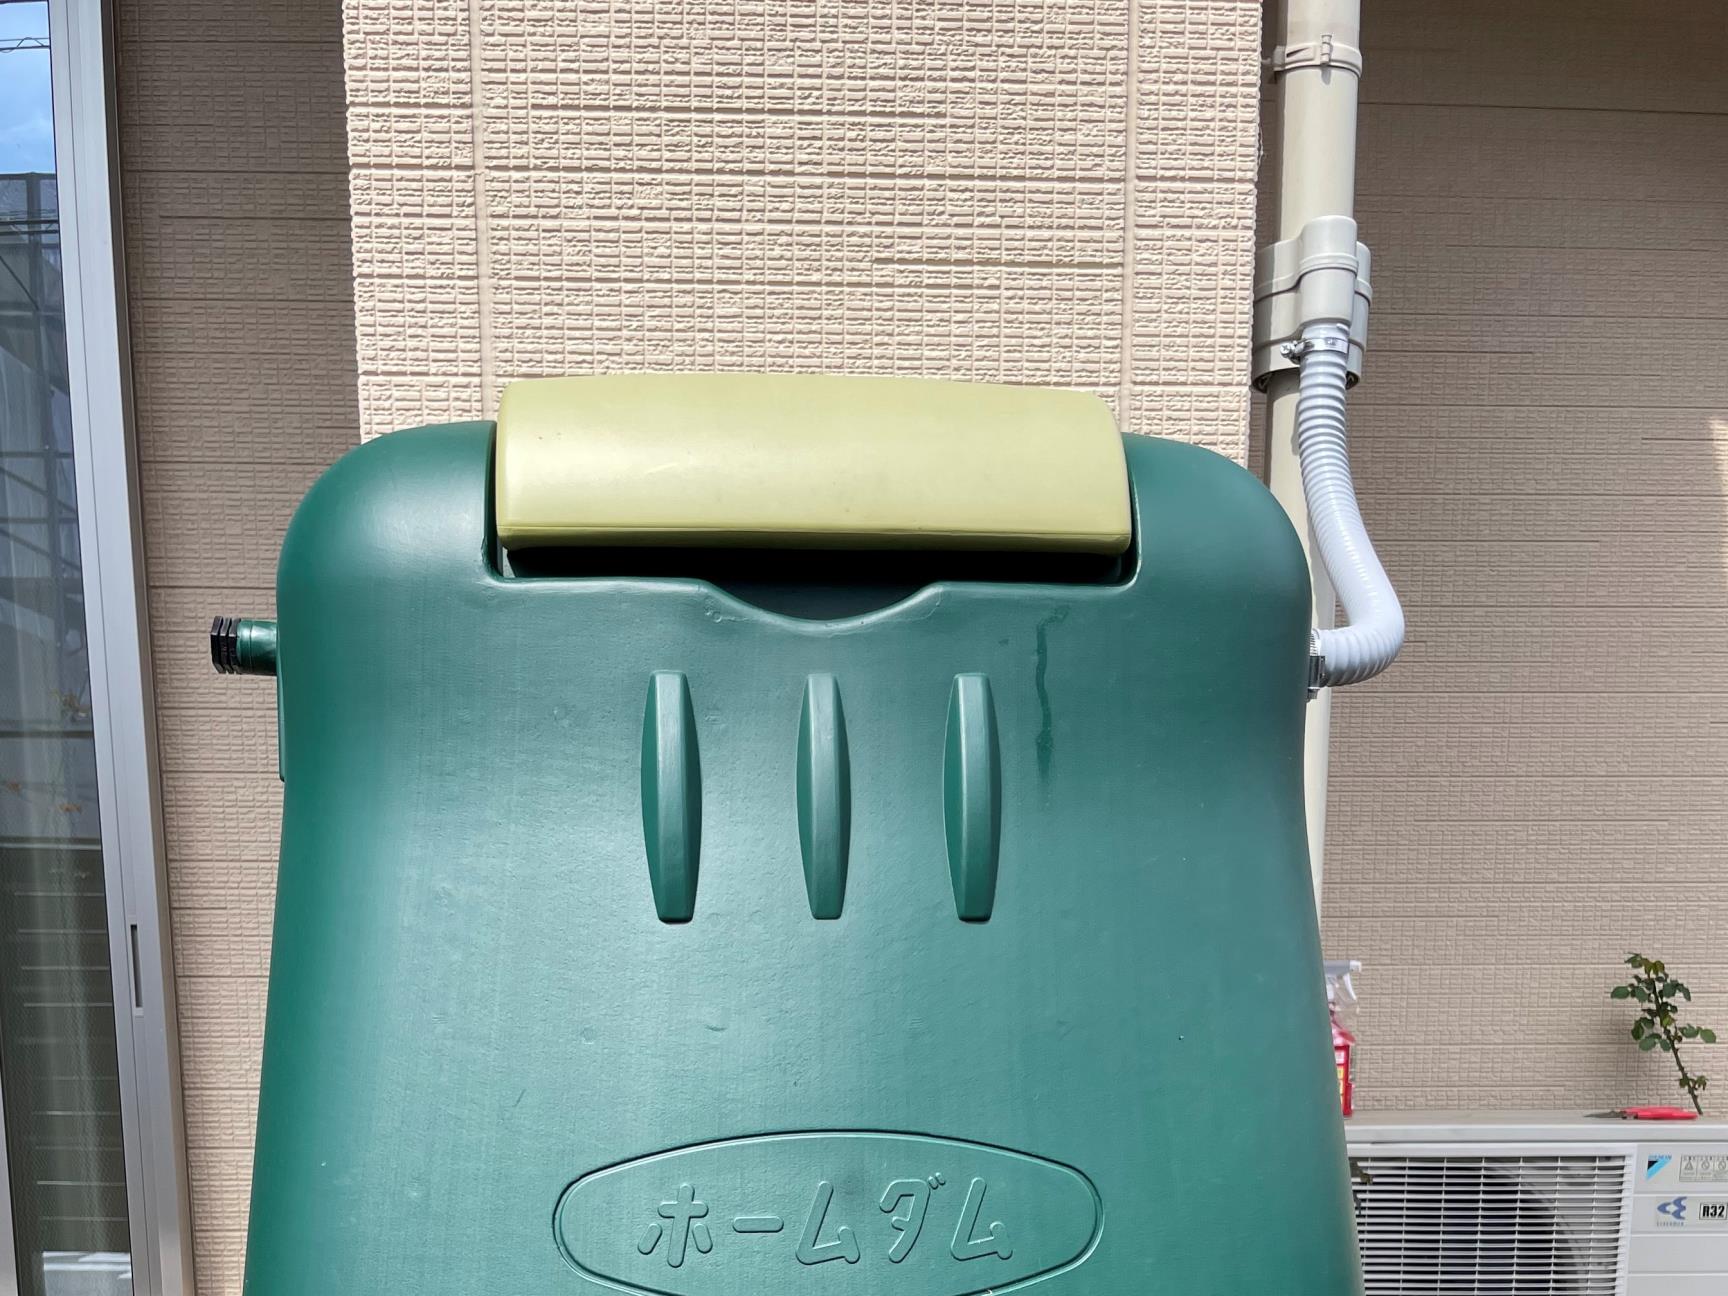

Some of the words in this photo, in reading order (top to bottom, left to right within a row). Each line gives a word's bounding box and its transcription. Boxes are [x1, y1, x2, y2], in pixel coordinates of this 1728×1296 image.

[637, 1172, 1013, 1268] ホームダム
[1702, 1205, 1725, 1218] R32
